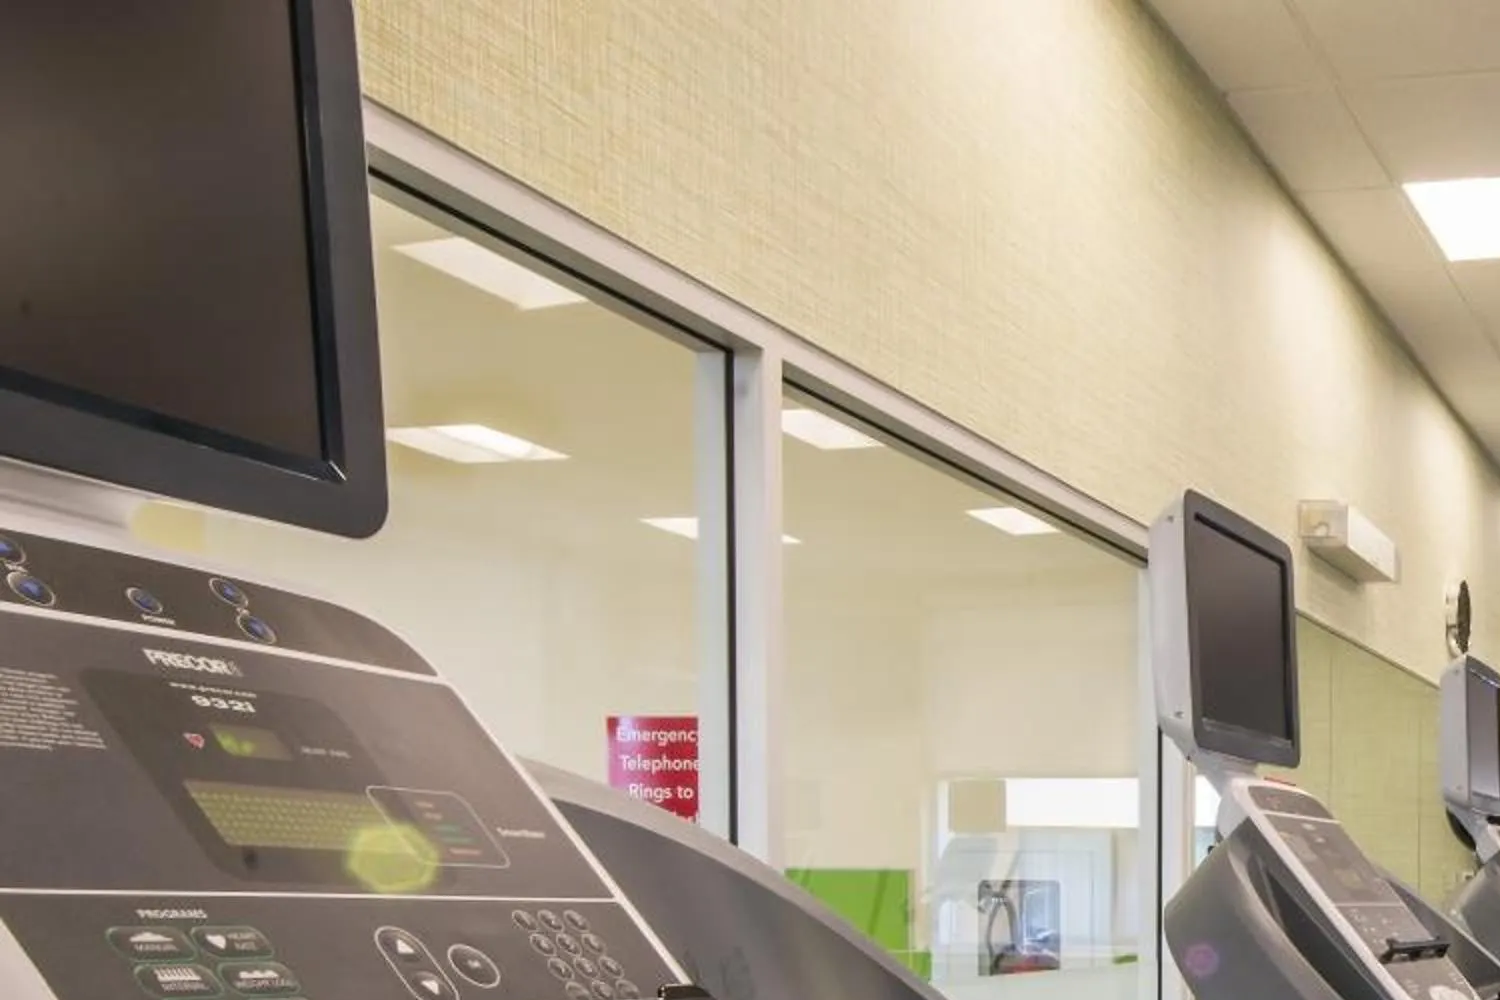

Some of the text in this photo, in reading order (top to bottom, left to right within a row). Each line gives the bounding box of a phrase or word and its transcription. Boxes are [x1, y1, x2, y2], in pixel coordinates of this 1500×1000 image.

[142, 648, 234, 675] PRECOR
[628, 783, 694, 803] Rings to
